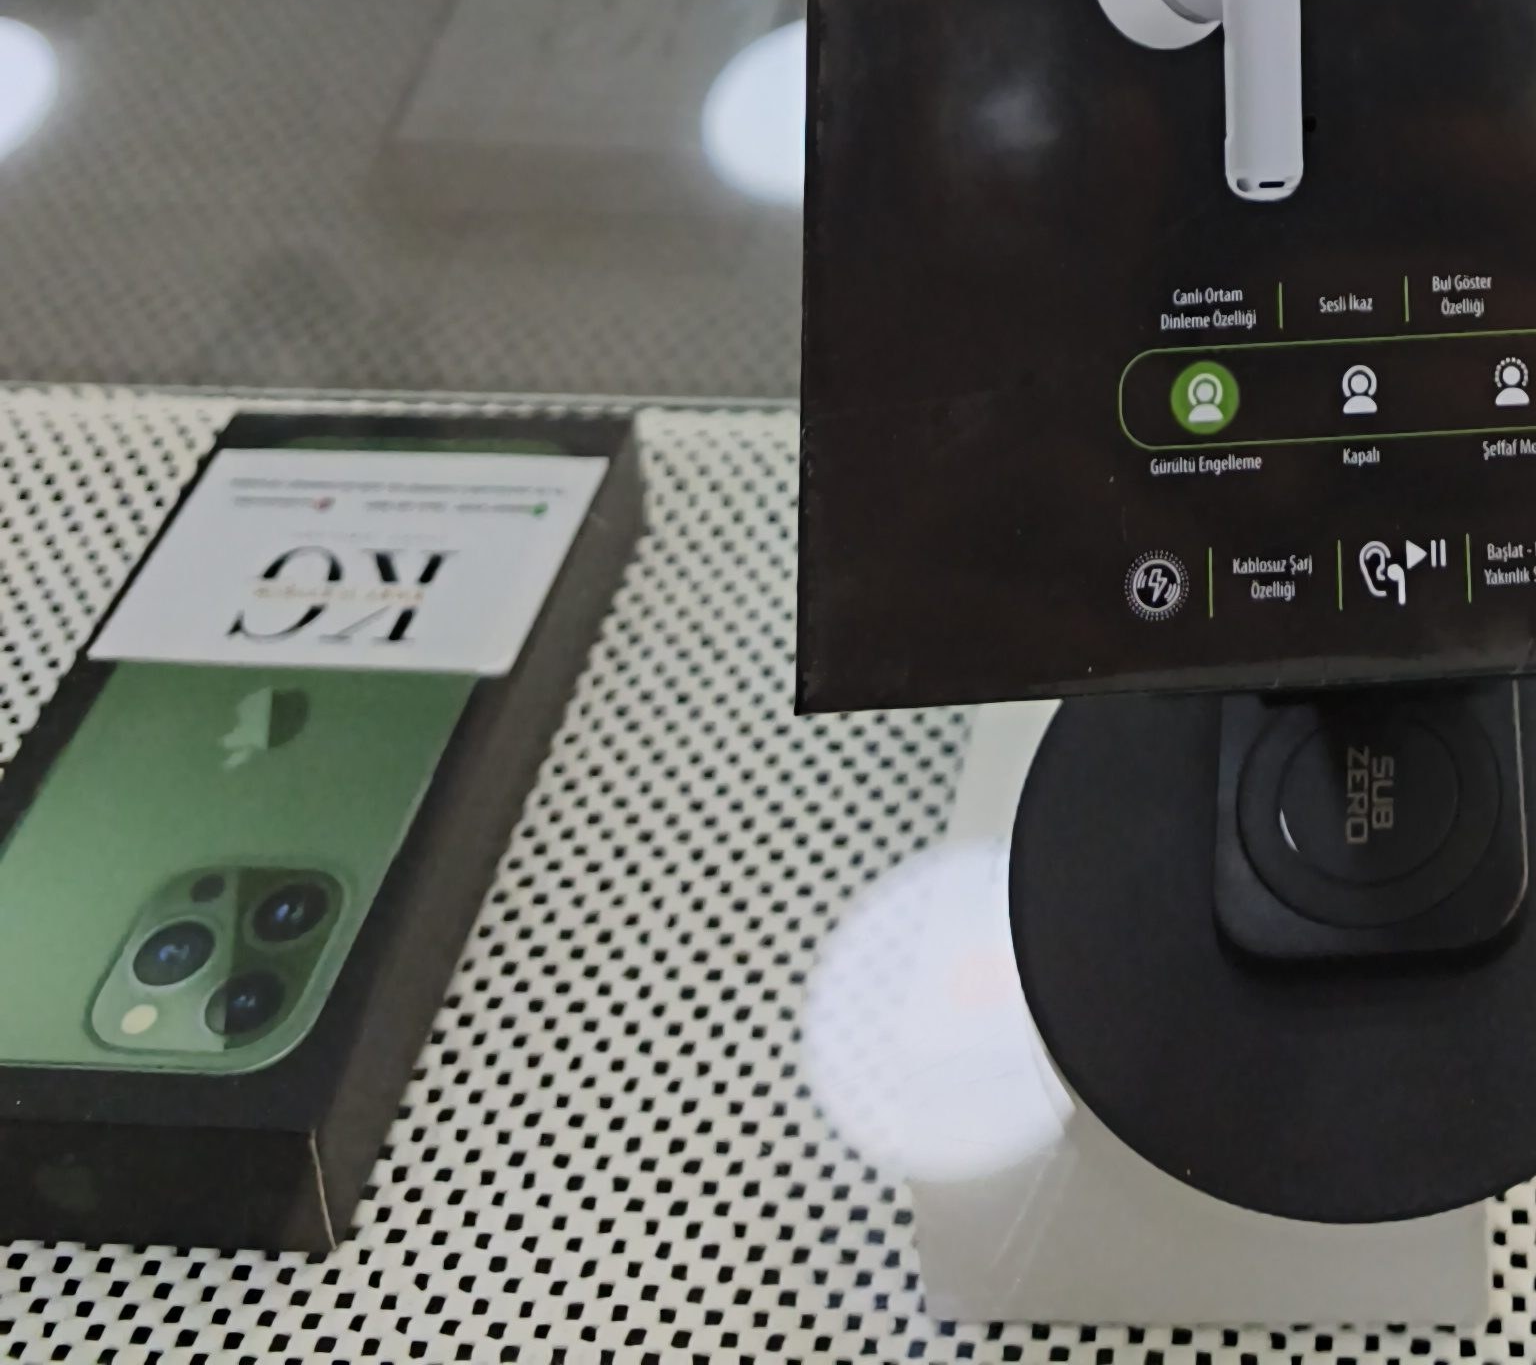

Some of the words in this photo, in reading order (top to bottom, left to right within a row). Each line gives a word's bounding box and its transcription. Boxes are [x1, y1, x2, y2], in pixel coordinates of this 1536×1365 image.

[1431, 274, 1452, 293] Bul
[1454, 273, 1493, 292] Göster
[1204, 286, 1244, 304] Ortam
[1319, 295, 1347, 314] Sesli
[1160, 312, 1211, 331] Dinleme
[1150, 455, 1197, 476] Gürültü
[1198, 453, 1263, 476] Engelleme
[1486, 540, 1524, 563] Başlat
[1232, 555, 1287, 575] Kablosuz
[1288, 553, 1313, 576] Şarj
[1344, 745, 1371, 845] ZERO
[1371, 755, 1395, 830] SUB
